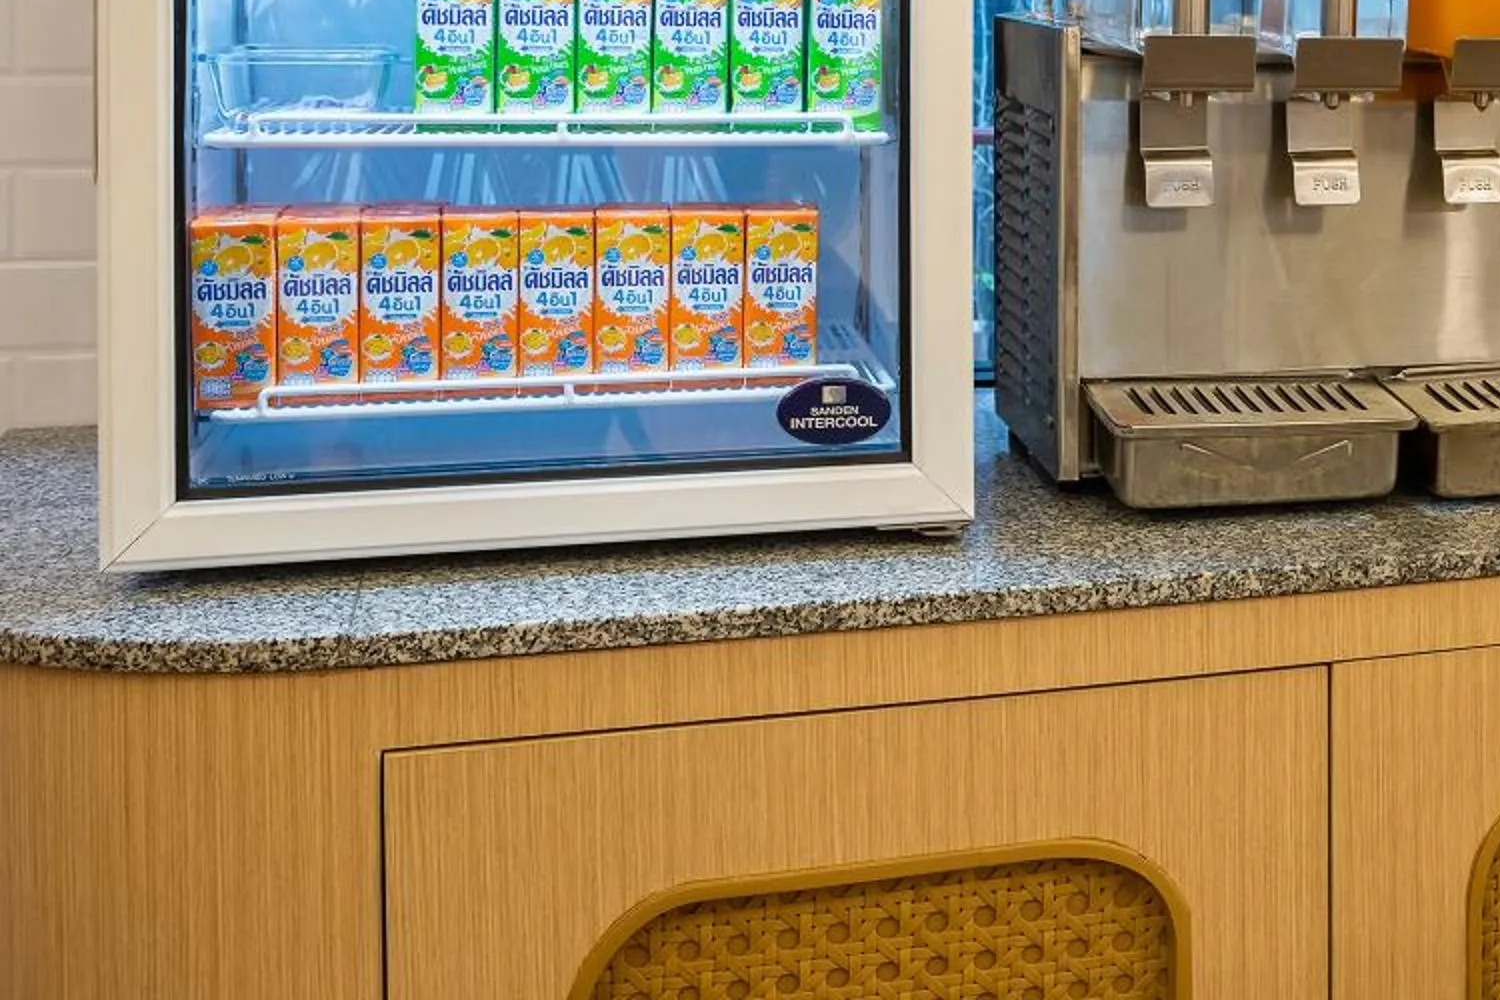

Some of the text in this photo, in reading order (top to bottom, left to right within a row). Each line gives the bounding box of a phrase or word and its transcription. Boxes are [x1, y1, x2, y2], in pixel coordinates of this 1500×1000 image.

[422, 3, 487, 26] ดัชมิลล์
[505, 4, 569, 27] ดัชมิลล์
[584, 4, 647, 27] ดัชมิลล์
[660, 6, 721, 27] ดัชมิลล์
[738, 6, 798, 28] ดัชมิลล์
[817, 8, 877, 29] ดัชมิลล์
[366, 271, 433, 294] ดัชมิลล์
[447, 269, 513, 292] ดัชมิลล์
[525, 267, 589, 289] ดัชมิลล์
[601, 264, 664, 287] ดัชมิลล์
[678, 263, 739, 286] ดัชมิลล์
[752, 262, 813, 284] ดัชมิลล์
[197, 279, 267, 301] ดัชมิลล์
[284, 274, 351, 297] ดัชมิลล์
[790, 415, 879, 429] INTERCOOL
[810, 405, 859, 417] SANDEN
